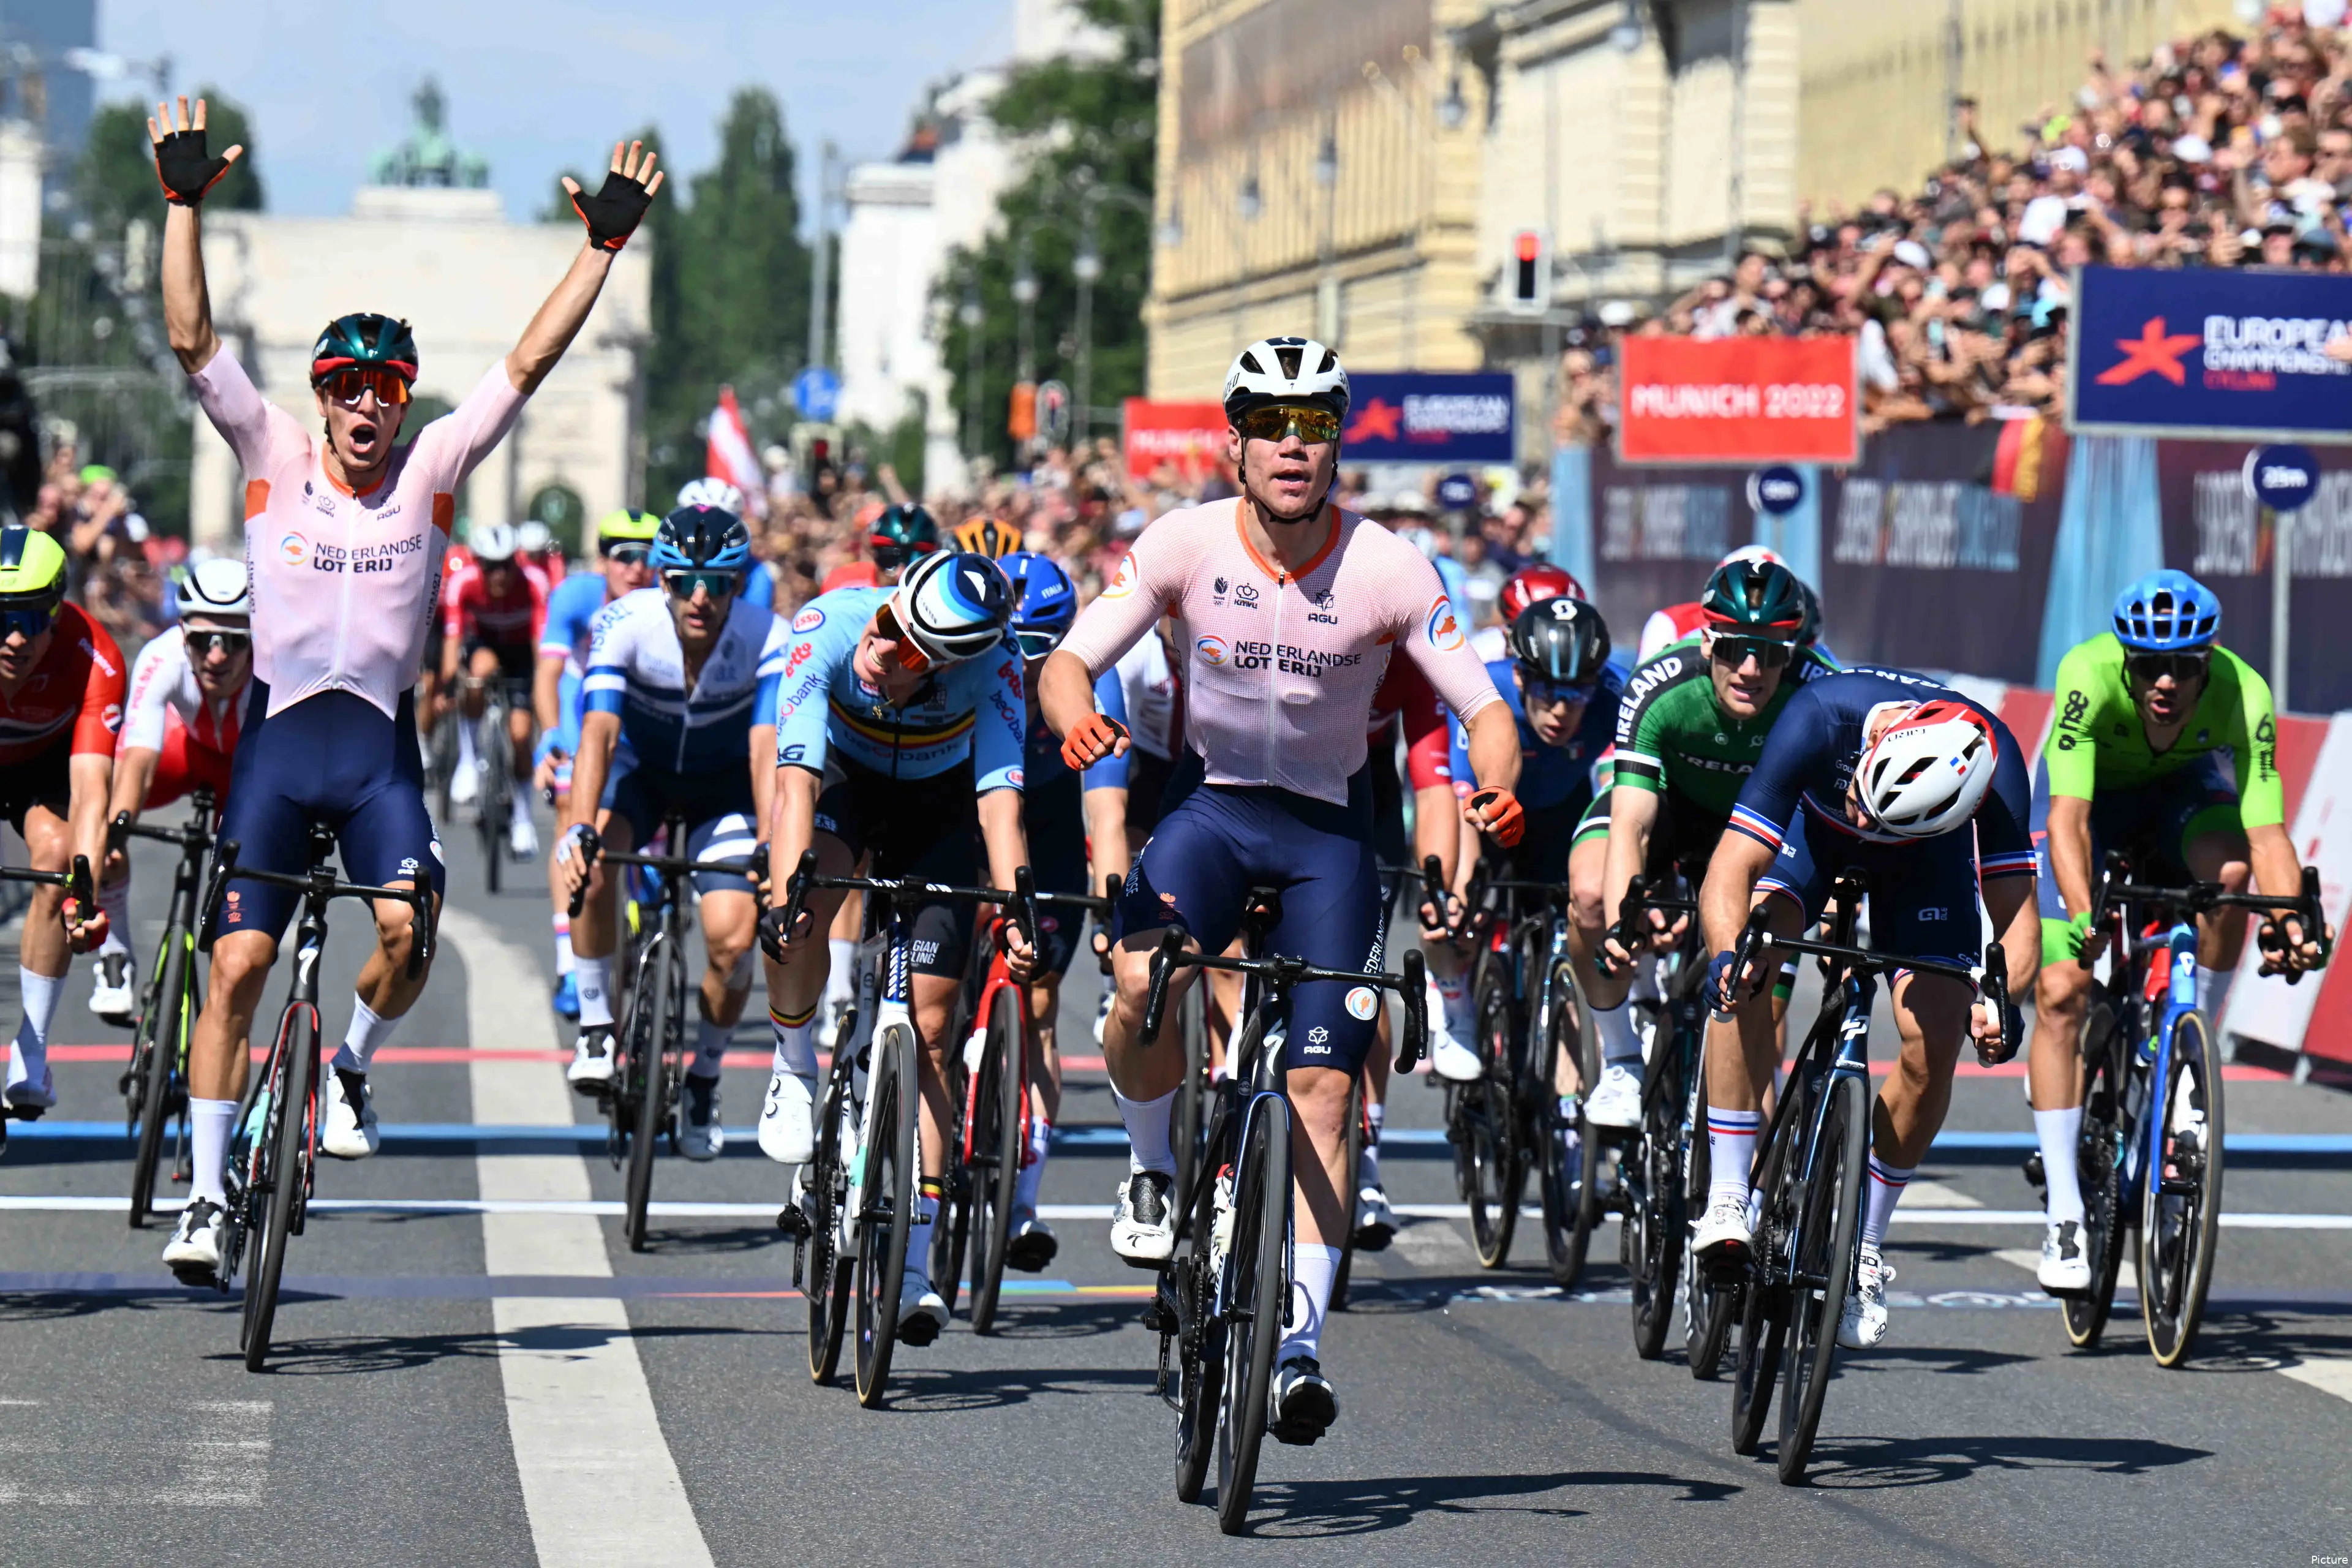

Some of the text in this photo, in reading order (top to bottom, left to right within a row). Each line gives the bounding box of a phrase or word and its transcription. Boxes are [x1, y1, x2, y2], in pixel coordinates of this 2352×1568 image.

[2203, 315, 2352, 353] EUROPEA
[1630, 383, 1845, 418] MUNICH 2022
[377, 505, 401, 521] AGU
[315, 534, 423, 560] NEDERLANDSE
[314, 557, 393, 573] LOTERIJ
[590, 603, 633, 652] ISRAEL
[1308, 613, 1338, 625] AGU
[1235, 640, 1362, 666] NEDERLANDSE
[1235, 655, 1322, 678] LOTERIJ
[1616, 657, 1683, 743] IRELAND
[1679, 752, 1754, 774] IRELA
[1303, 1046, 1332, 1055] AGU
